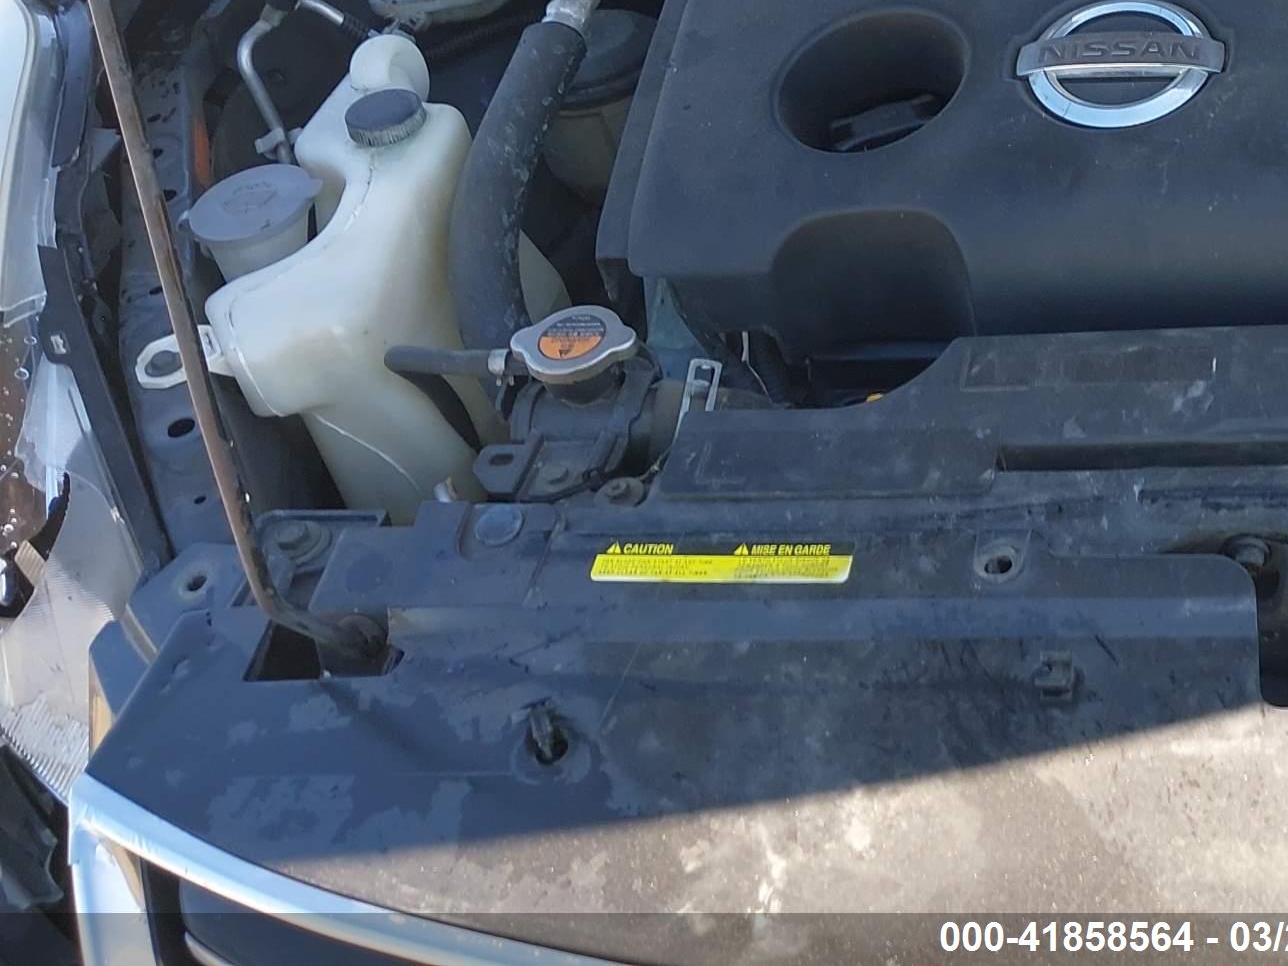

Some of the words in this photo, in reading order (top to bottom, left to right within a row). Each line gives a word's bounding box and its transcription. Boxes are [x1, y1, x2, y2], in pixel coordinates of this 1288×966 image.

[1039, 40, 1198, 60] NISSAN
[623, 543, 674, 555] CAUTION
[751, 544, 778, 556] MISE
[778, 544, 794, 556] EN
[794, 544, 832, 556] GARDE
